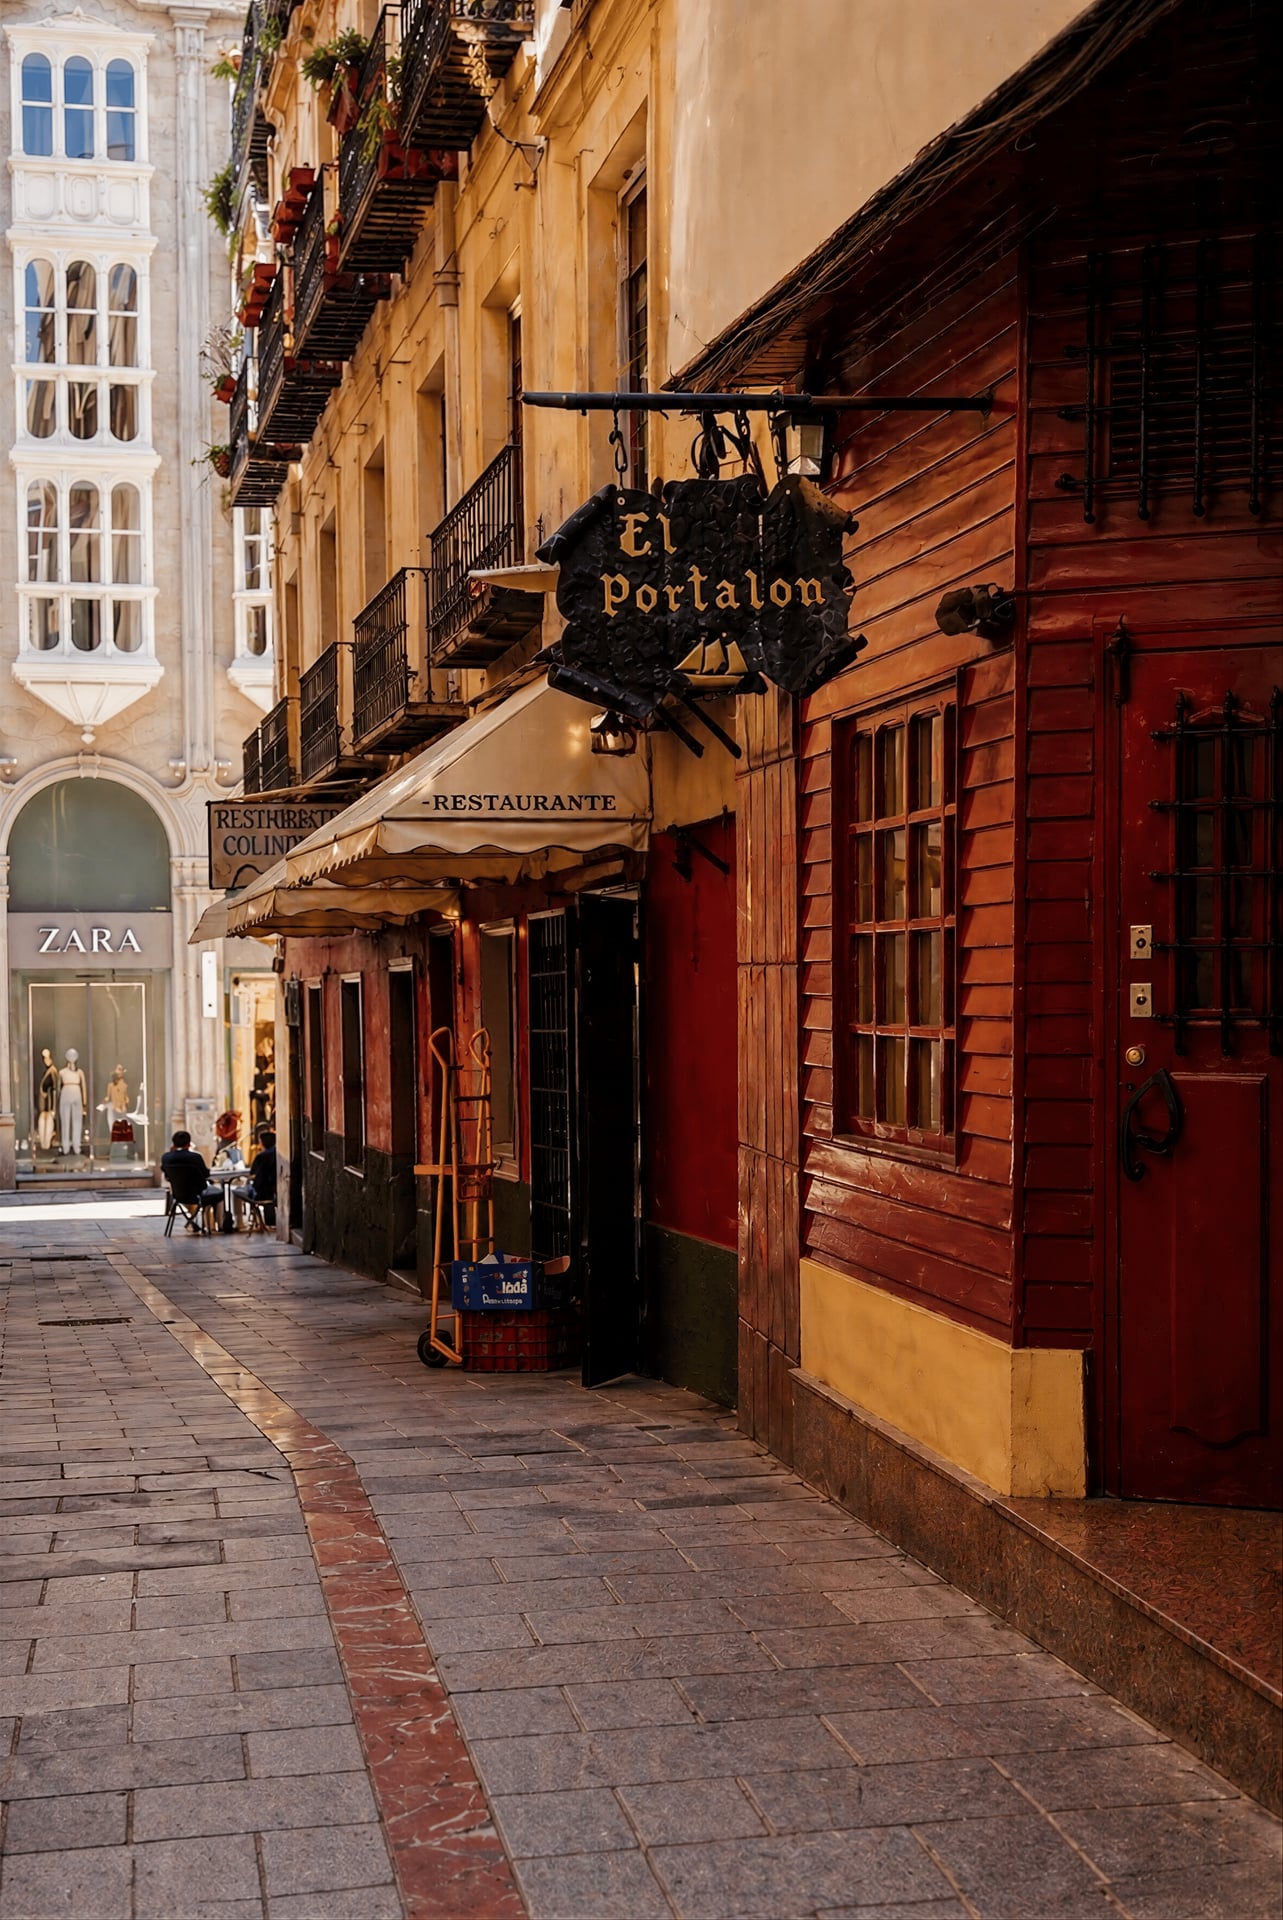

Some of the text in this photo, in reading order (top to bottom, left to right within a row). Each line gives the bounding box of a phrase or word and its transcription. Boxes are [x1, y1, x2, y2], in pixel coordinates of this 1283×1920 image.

[619, 512, 677, 557] El
[600, 565, 826, 618] Portalon
[38, 928, 142, 953] ZARA
